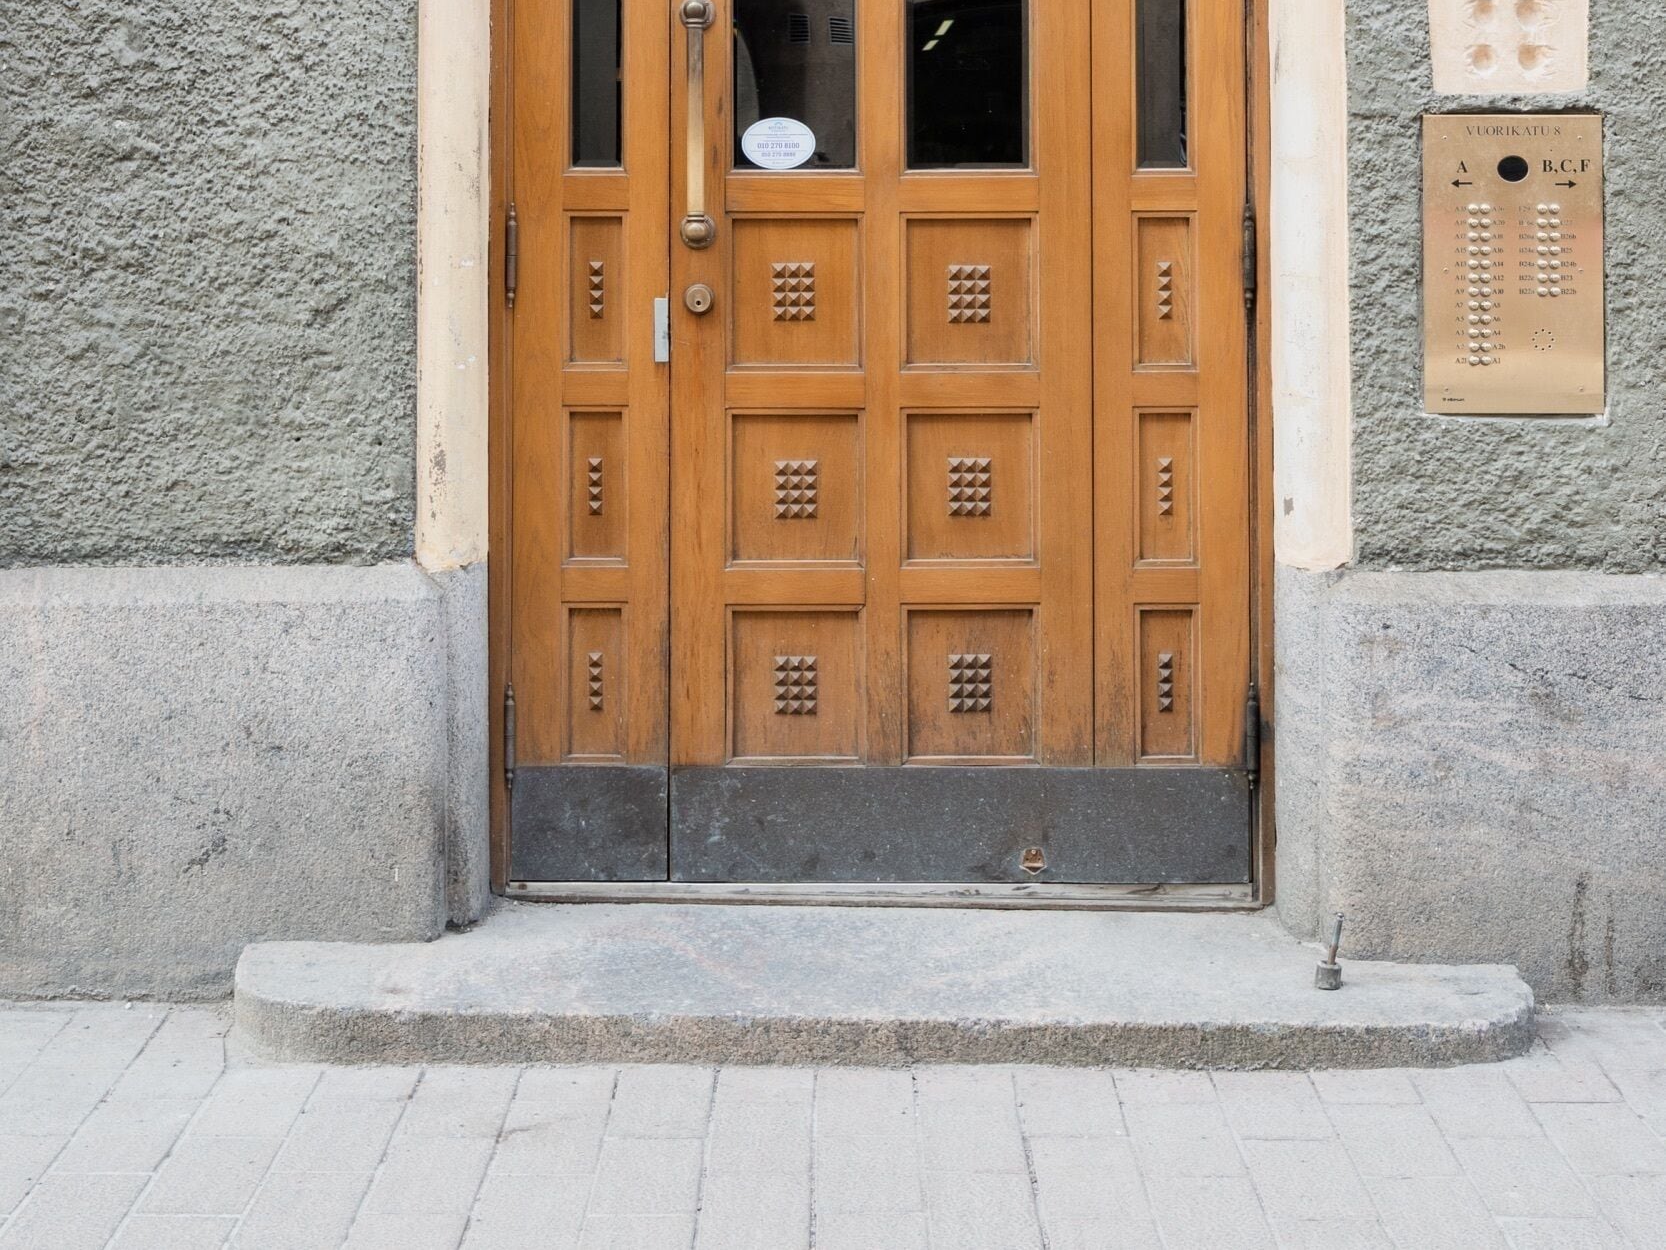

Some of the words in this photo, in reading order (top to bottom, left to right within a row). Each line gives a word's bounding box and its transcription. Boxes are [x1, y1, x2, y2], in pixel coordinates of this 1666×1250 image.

[1466, 125, 1550, 136] VUORIKATU
[1553, 125, 1562, 136] 8
[1456, 160, 1468, 174] A
